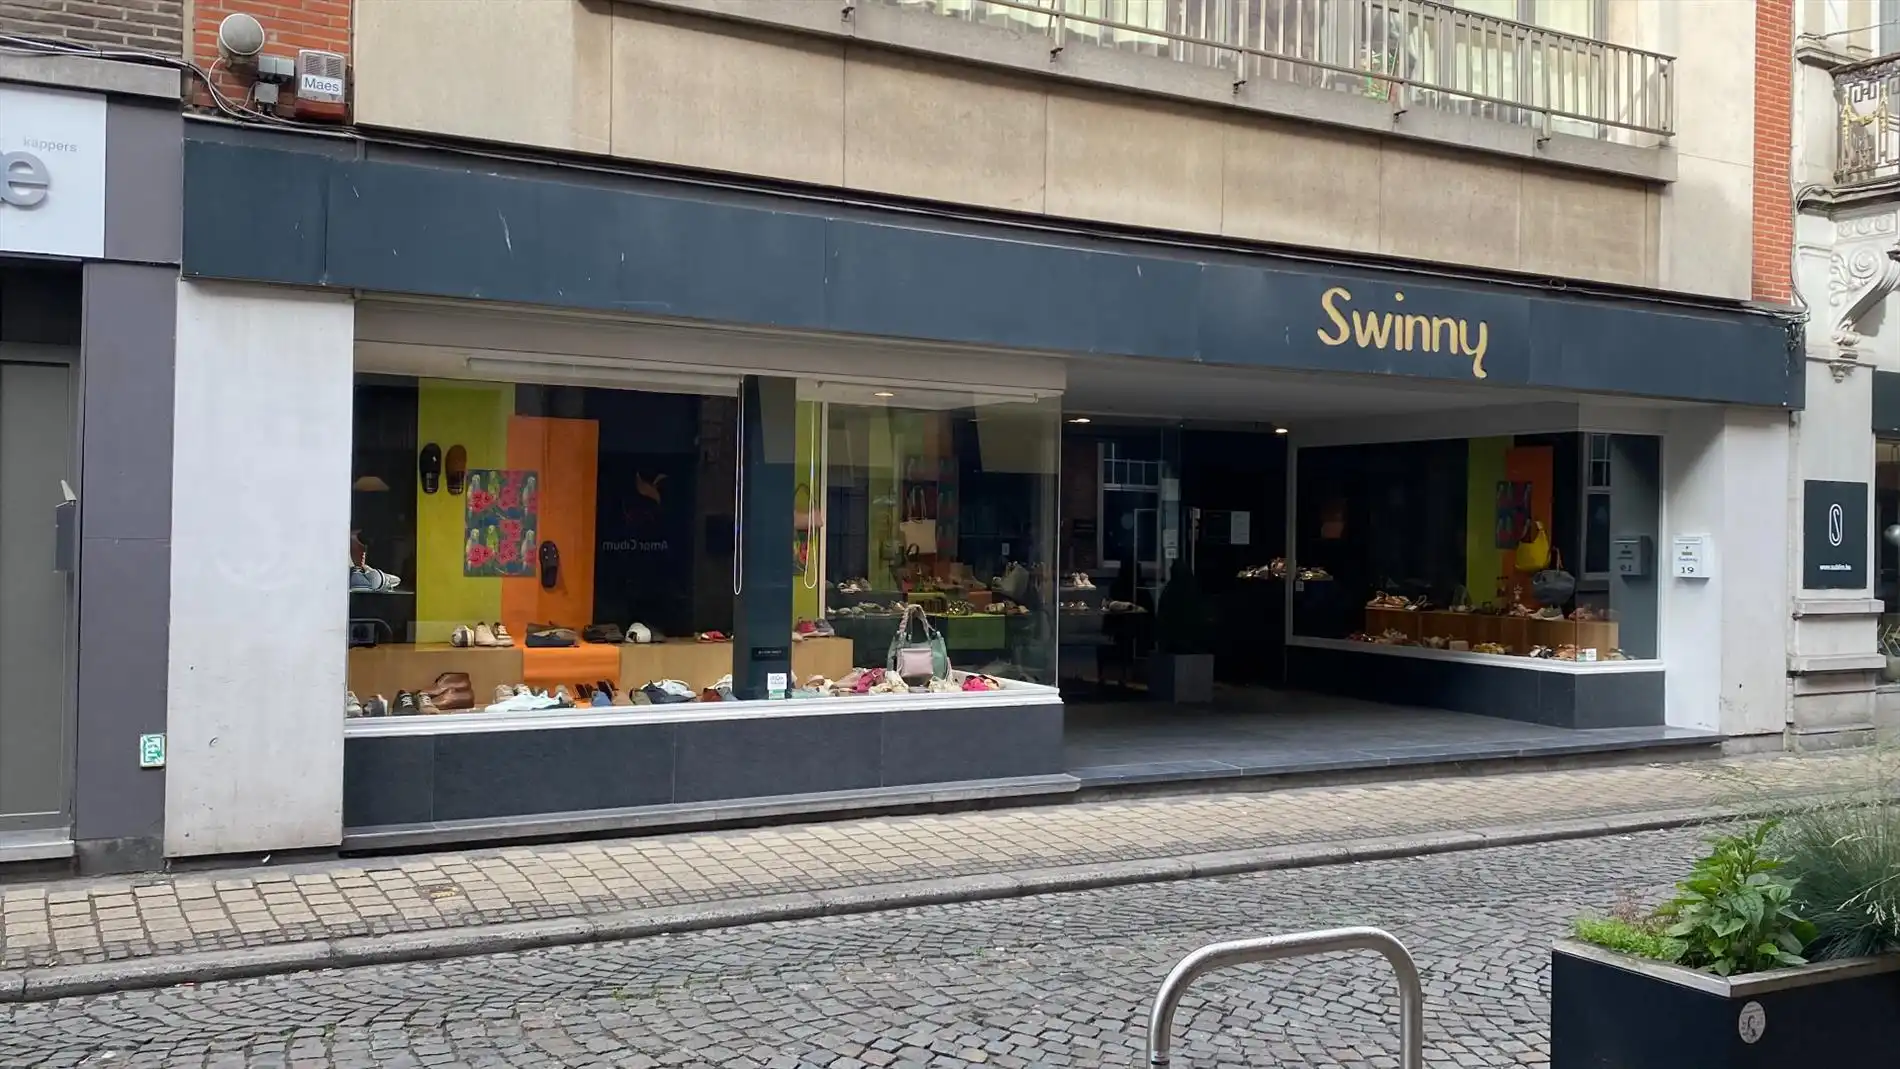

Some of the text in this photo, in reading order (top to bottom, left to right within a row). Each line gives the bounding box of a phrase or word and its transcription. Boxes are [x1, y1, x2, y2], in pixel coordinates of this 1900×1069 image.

[304, 76, 340, 92] Maes
[1316, 286, 1489, 379] Swinny
[1681, 566, 1694, 574] 19
